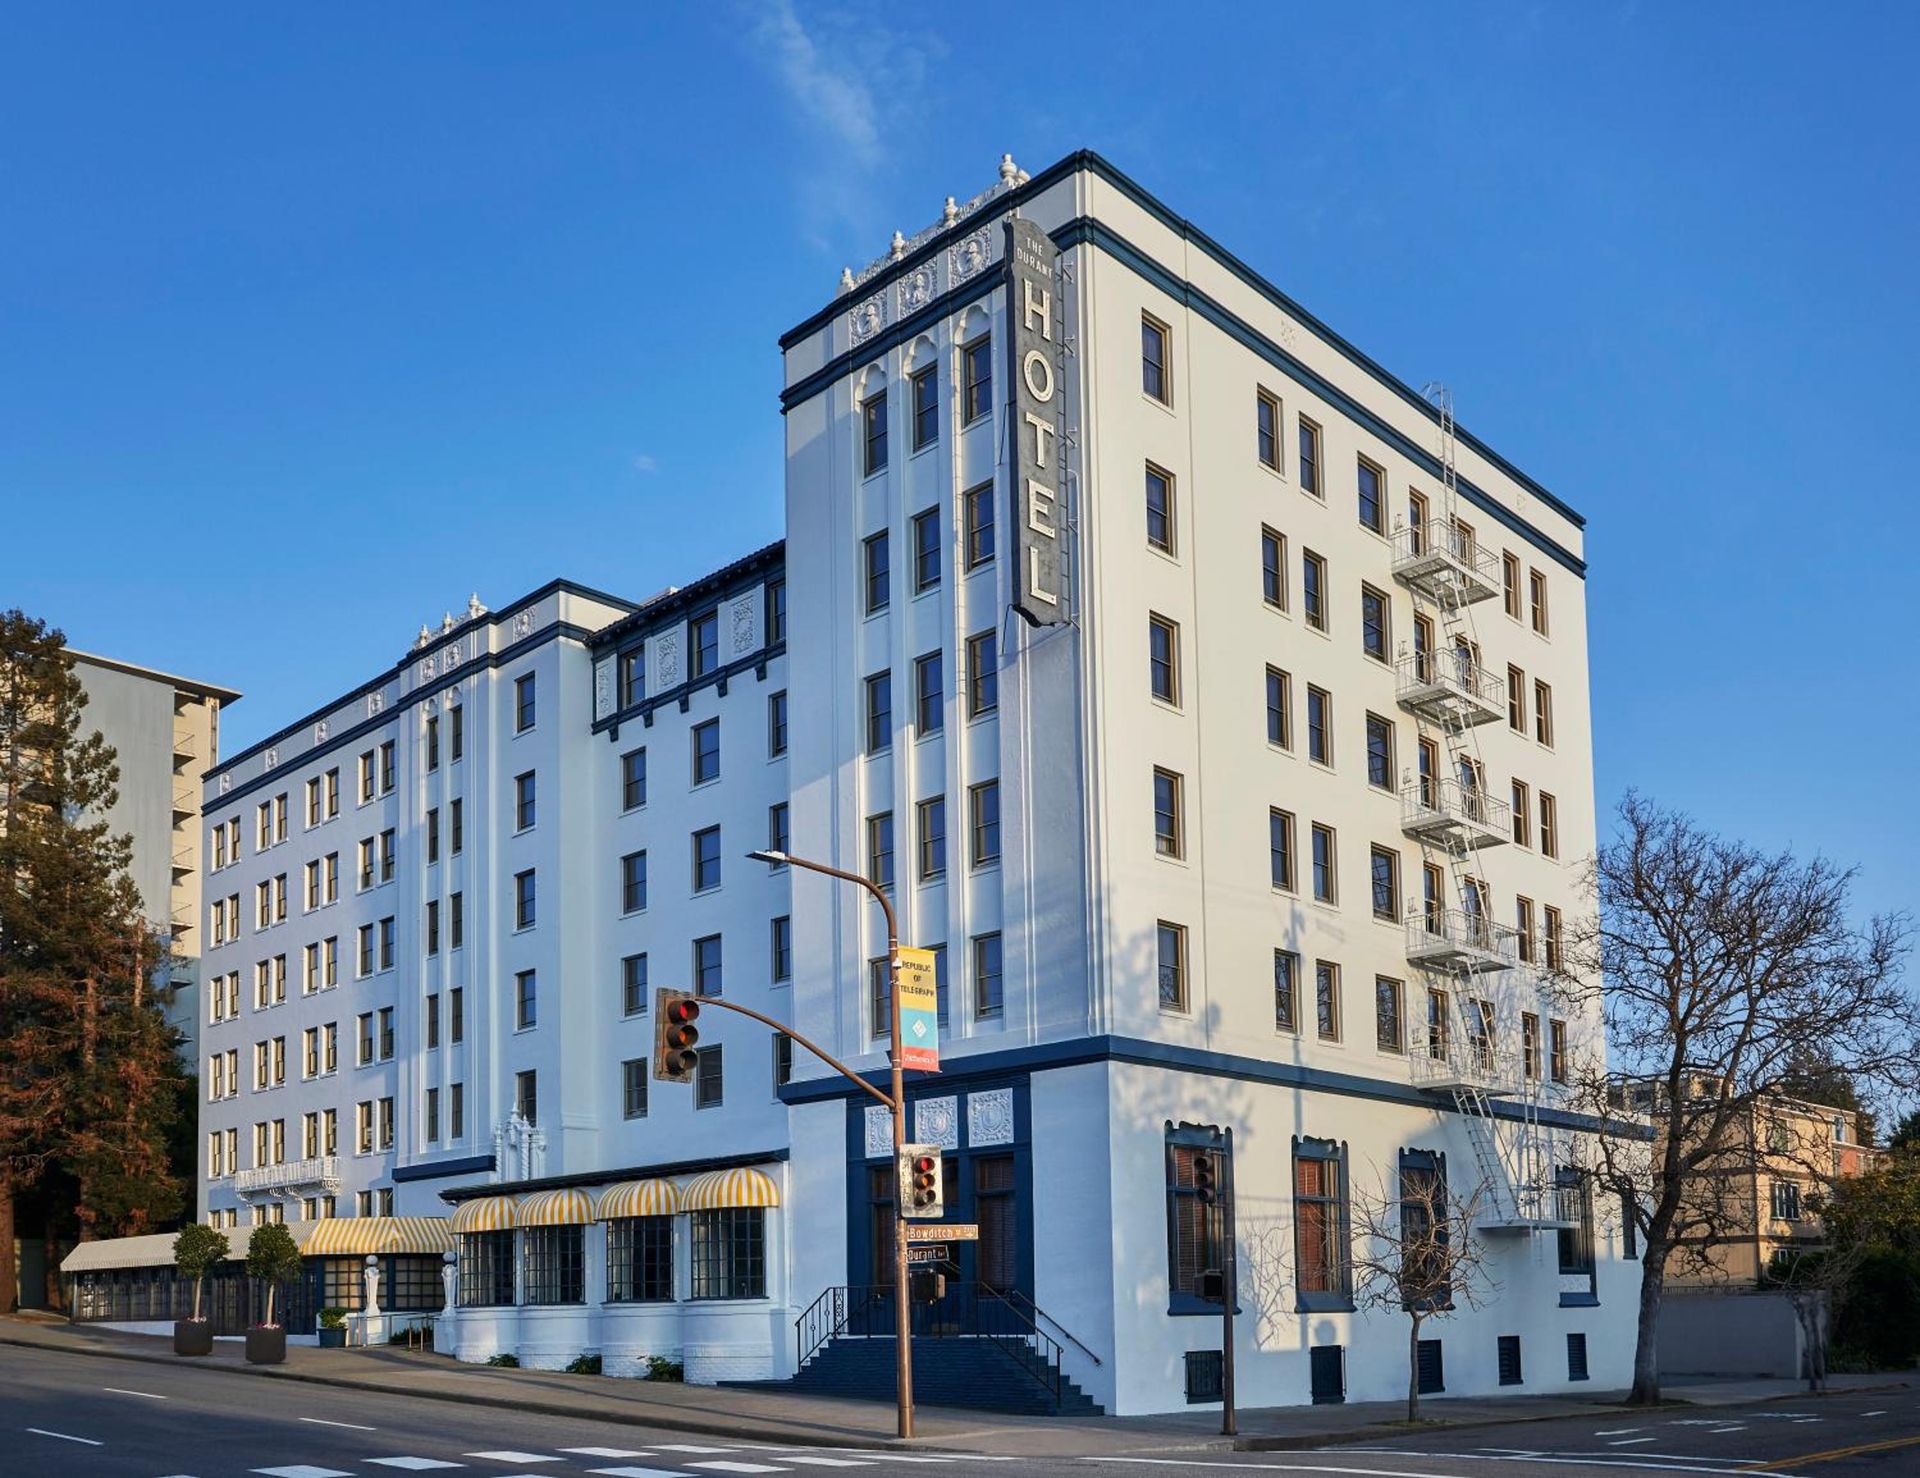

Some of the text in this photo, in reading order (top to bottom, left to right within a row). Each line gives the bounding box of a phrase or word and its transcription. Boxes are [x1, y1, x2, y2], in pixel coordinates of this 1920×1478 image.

[1026, 237, 1044, 256] THE
[1017, 247, 1053, 278] DURANT
[1023, 278, 1057, 606] HOTEL
[902, 960, 931, 972] REPUBLIC
[913, 974, 922, 982] OF
[900, 984, 935, 997] TELEGRAPH
[909, 1227, 953, 1238] Bowditch
[908, 1249, 937, 1260] Durant
